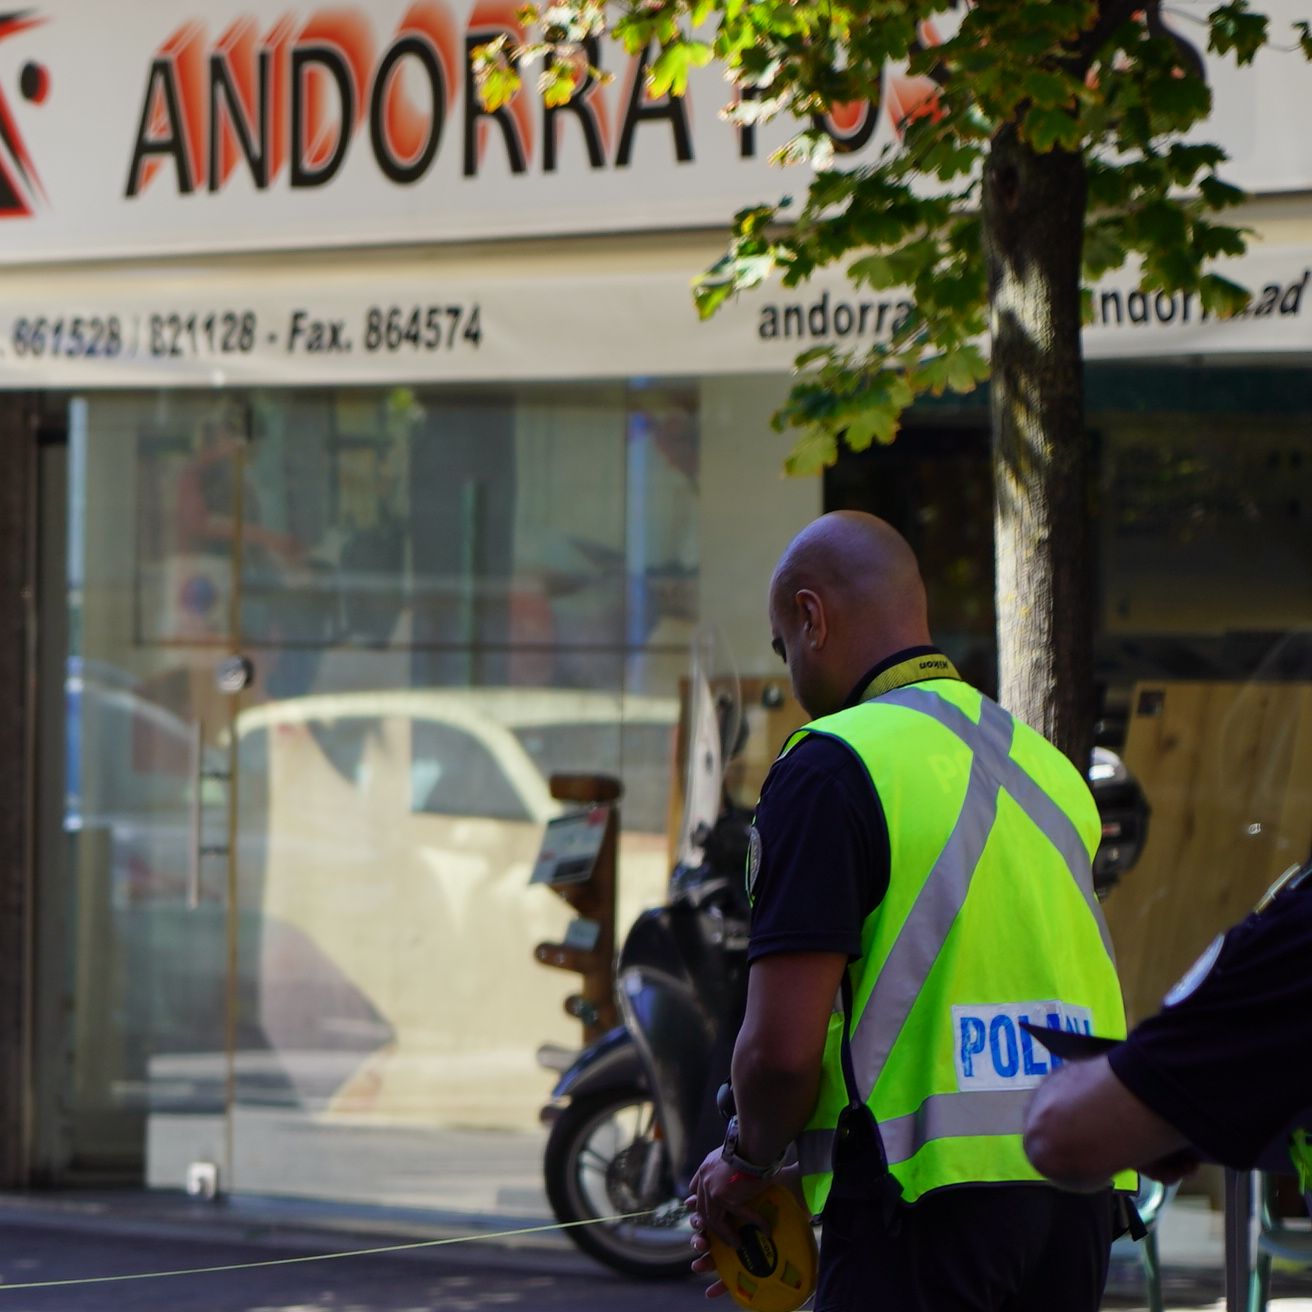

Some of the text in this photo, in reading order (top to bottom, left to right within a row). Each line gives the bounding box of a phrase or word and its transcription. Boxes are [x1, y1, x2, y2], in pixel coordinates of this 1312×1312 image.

[13, 315, 122, 358] 661528
[149, 305, 257, 358] 821128
[287, 308, 352, 353] Fax.
[364, 302, 482, 351] 864574
